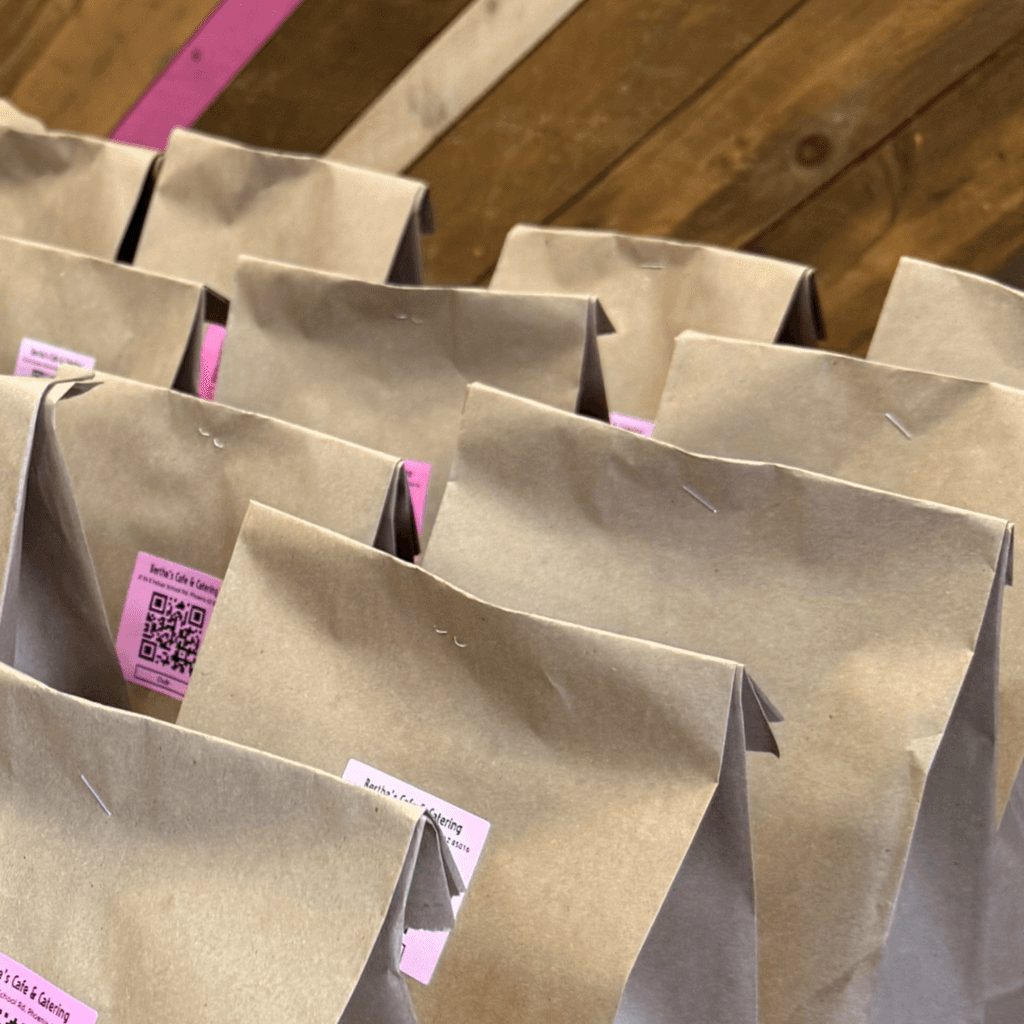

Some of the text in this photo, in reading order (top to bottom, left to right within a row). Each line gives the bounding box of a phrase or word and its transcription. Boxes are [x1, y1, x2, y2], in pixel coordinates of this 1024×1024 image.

[11, 975, 29, 995] Cafe
[30, 986, 37, 1000] &
[38, 991, 71, 1024] Catering
